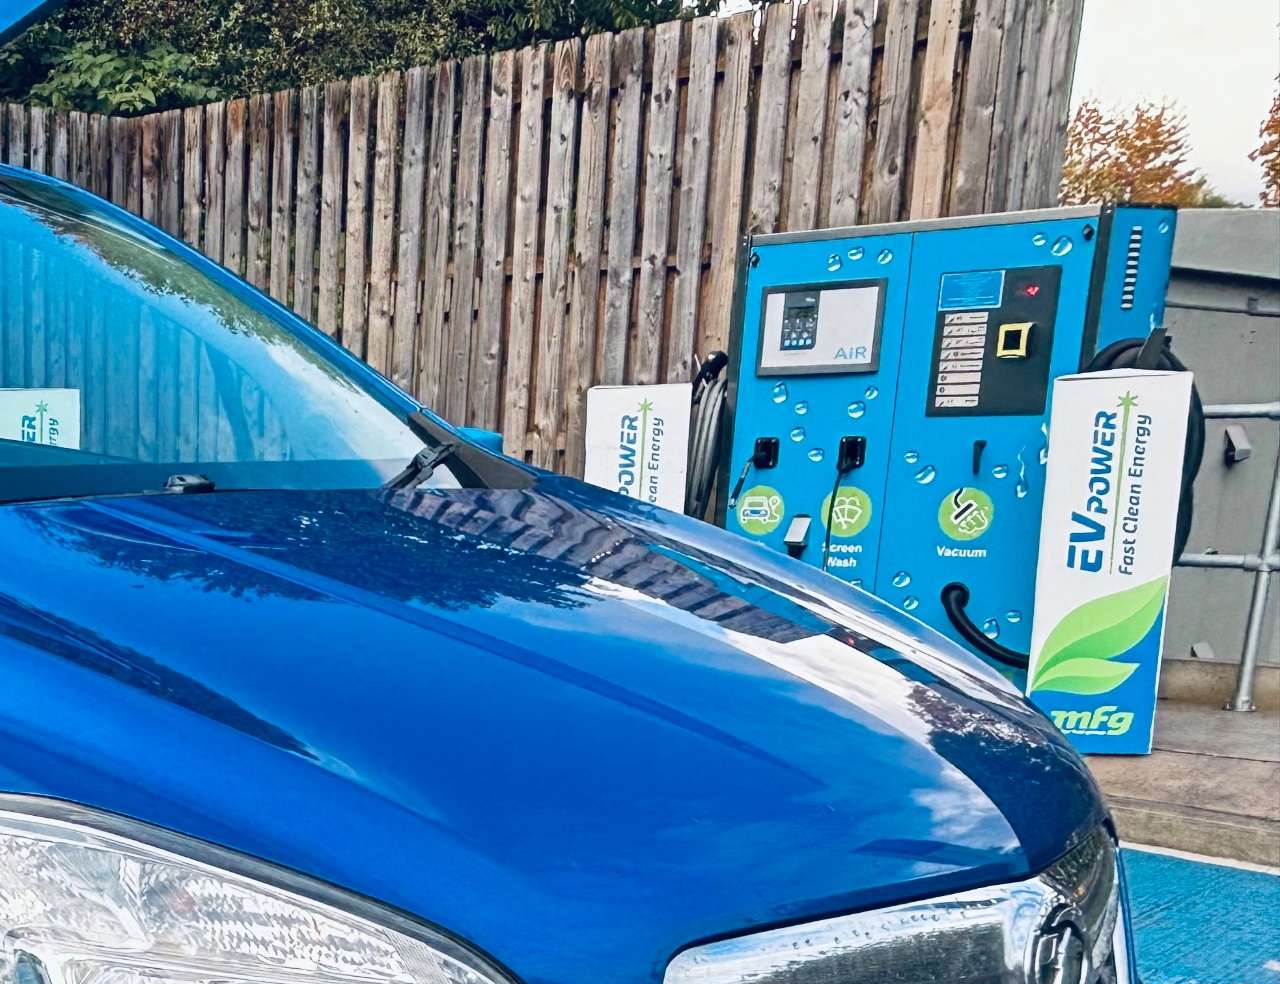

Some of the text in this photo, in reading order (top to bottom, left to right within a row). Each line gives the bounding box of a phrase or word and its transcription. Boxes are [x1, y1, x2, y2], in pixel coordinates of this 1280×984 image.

[647, 417, 664, 471] Energy
[1118, 414, 1152, 575] Fast Clean Energy
[936, 546, 987, 558] Vacuum
[1051, 705, 1135, 735] mfg
